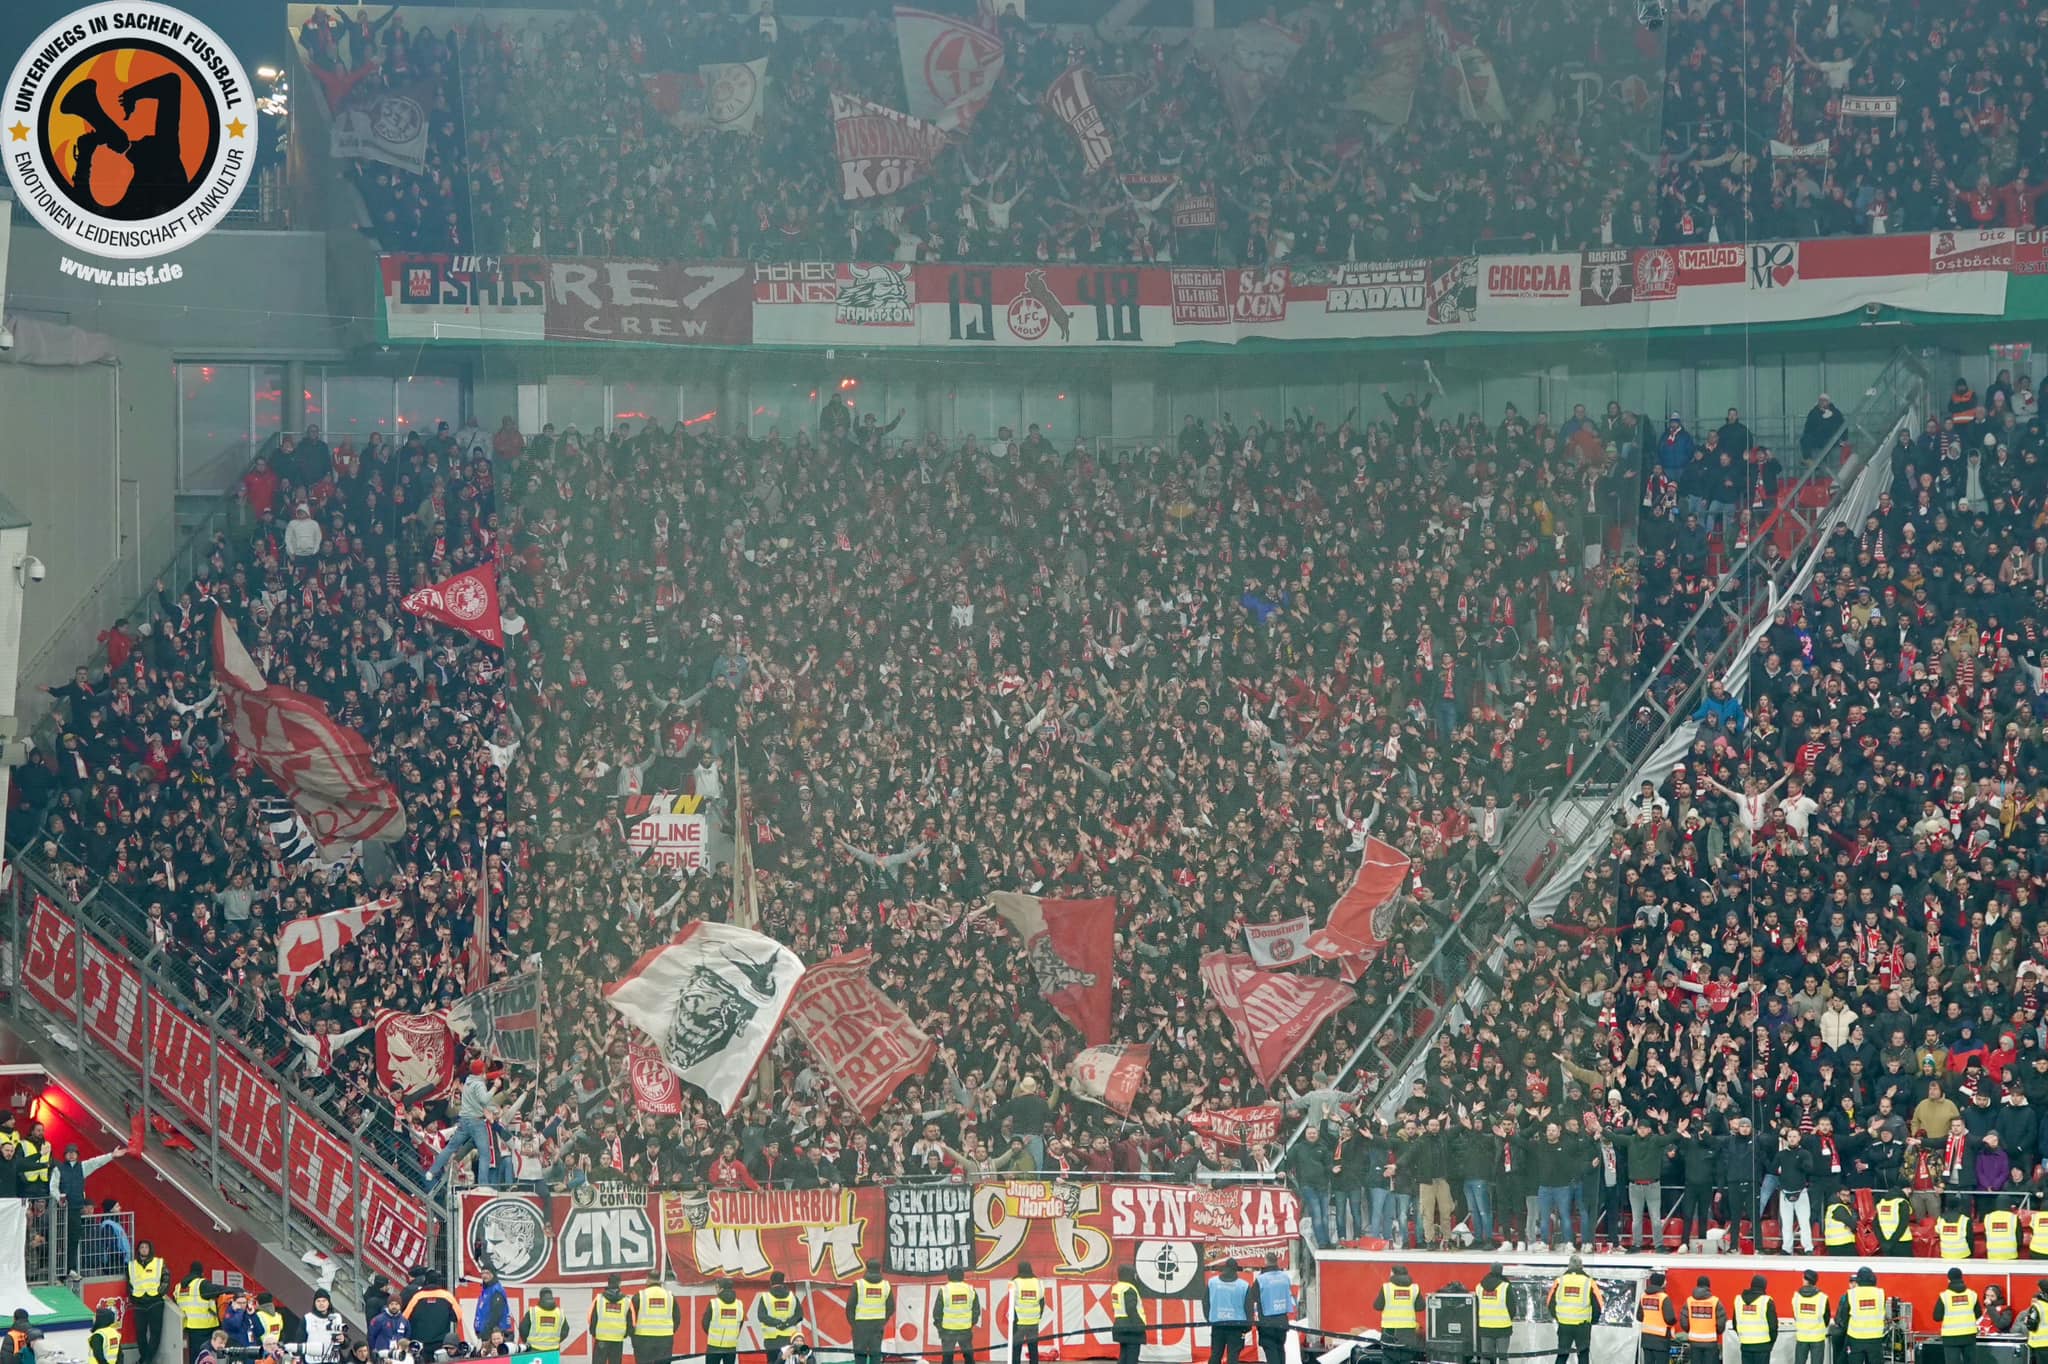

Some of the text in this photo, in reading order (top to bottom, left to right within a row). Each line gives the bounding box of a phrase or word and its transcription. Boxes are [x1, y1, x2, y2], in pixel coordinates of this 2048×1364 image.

[1488, 264, 1572, 291] CRICCAA
[1328, 286, 1425, 312] RADAU
[584, 317, 707, 336] CREW
[631, 823, 701, 842] EDLINE
[127, 985, 429, 1256] DURCHSETZ
[600, 1194, 624, 1207] CON
[889, 1189, 970, 1214] SEKTION
[1008, 1181, 1045, 1202] Junge
[708, 1190, 842, 1225] STADIONVERBOT
[1020, 1199, 1063, 1218] Horde
[1111, 1187, 1299, 1237] SYNKAT
[565, 1209, 648, 1268] CNS
[890, 1212, 970, 1247] STADT
[890, 1245, 970, 1272] VERBOT
